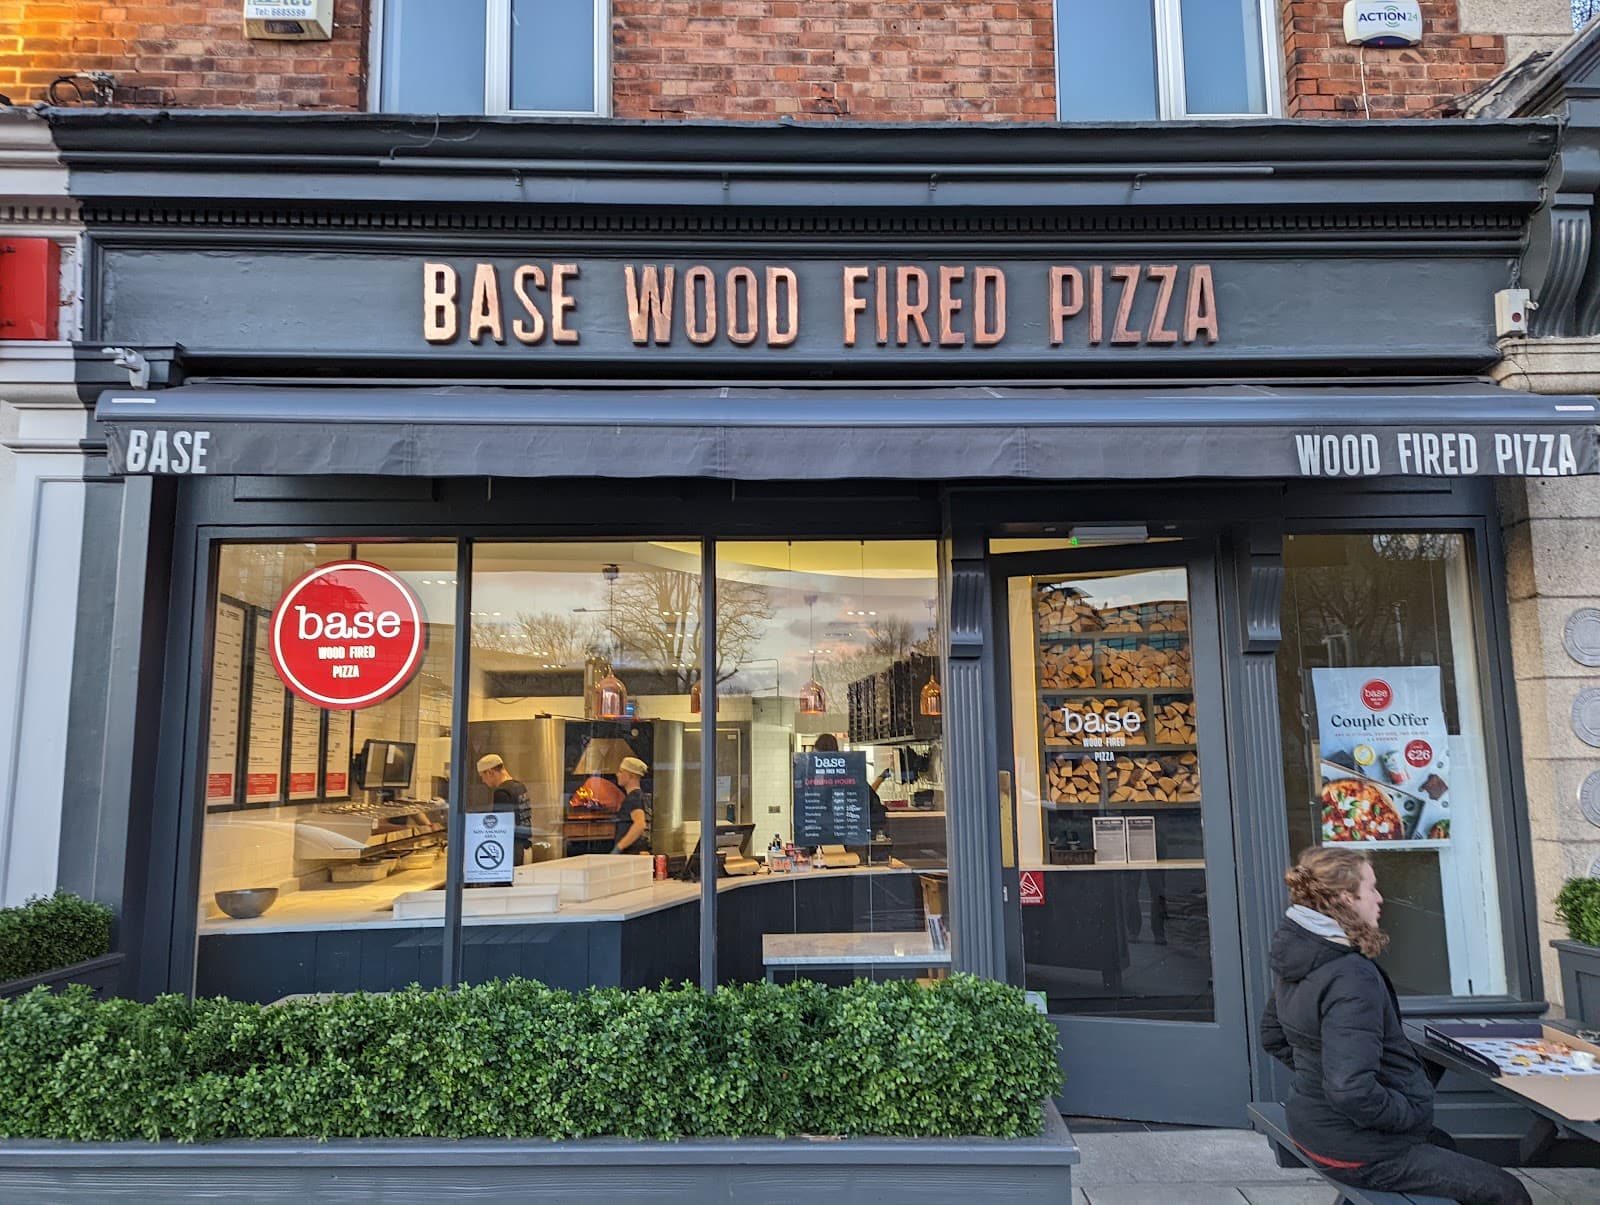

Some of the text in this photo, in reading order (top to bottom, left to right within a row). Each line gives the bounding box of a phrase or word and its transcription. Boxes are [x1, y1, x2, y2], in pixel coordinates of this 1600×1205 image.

[423, 262, 1219, 346] BASE WOOD FIRED PIZZA
[126, 429, 211, 474] BASE
[1295, 433, 1577, 476] WOOD FIRED PIZZA
[294, 605, 401, 640] base
[318, 645, 376, 660] WOOD FIRED
[332, 664, 360, 679] PIZZA
[1060, 707, 1141, 733] base
[1331, 713, 1430, 731] Couple Offer
[1082, 737, 1103, 747] WOOD
[814, 755, 846, 768] base
[1094, 751, 1115, 762] PIZZA
[1407, 749, 1431, 761] €26
